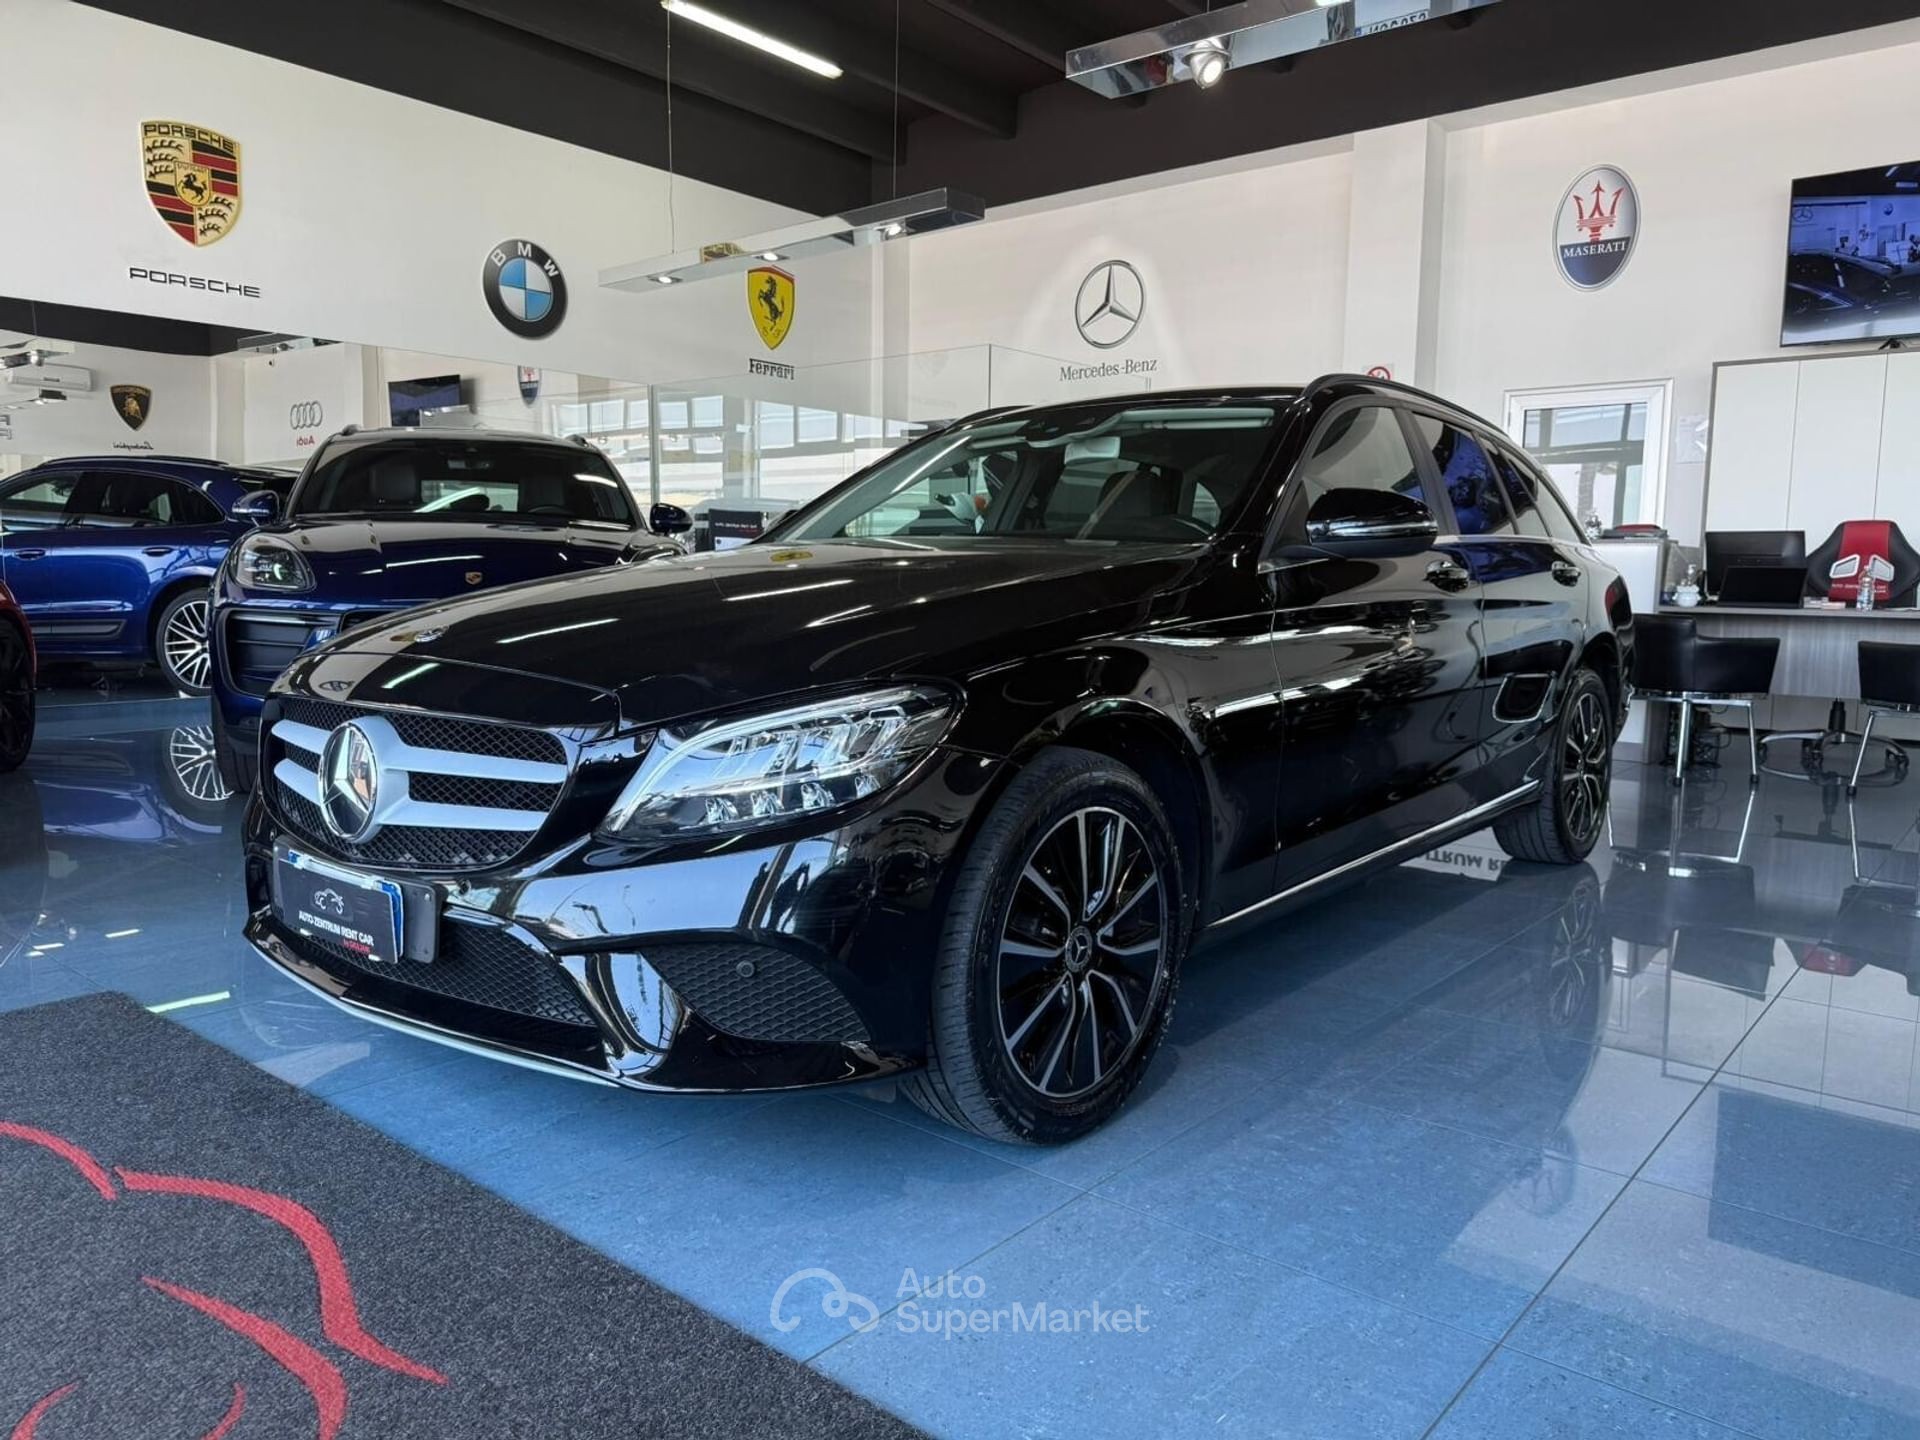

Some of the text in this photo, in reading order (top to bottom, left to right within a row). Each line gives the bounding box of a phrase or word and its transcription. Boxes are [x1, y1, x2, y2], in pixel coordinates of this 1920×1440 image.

[143, 124, 235, 151] PORSCHE
[491, 241, 559, 277] BMW
[1563, 240, 1627, 259] MASERATI
[129, 267, 261, 298] PORSCHE
[749, 358, 795, 380] Ferrari
[1060, 359, 1158, 381] Mercedes-Benz
[298, 910, 314, 925] AUTO
[358, 932, 374, 947] CAR
